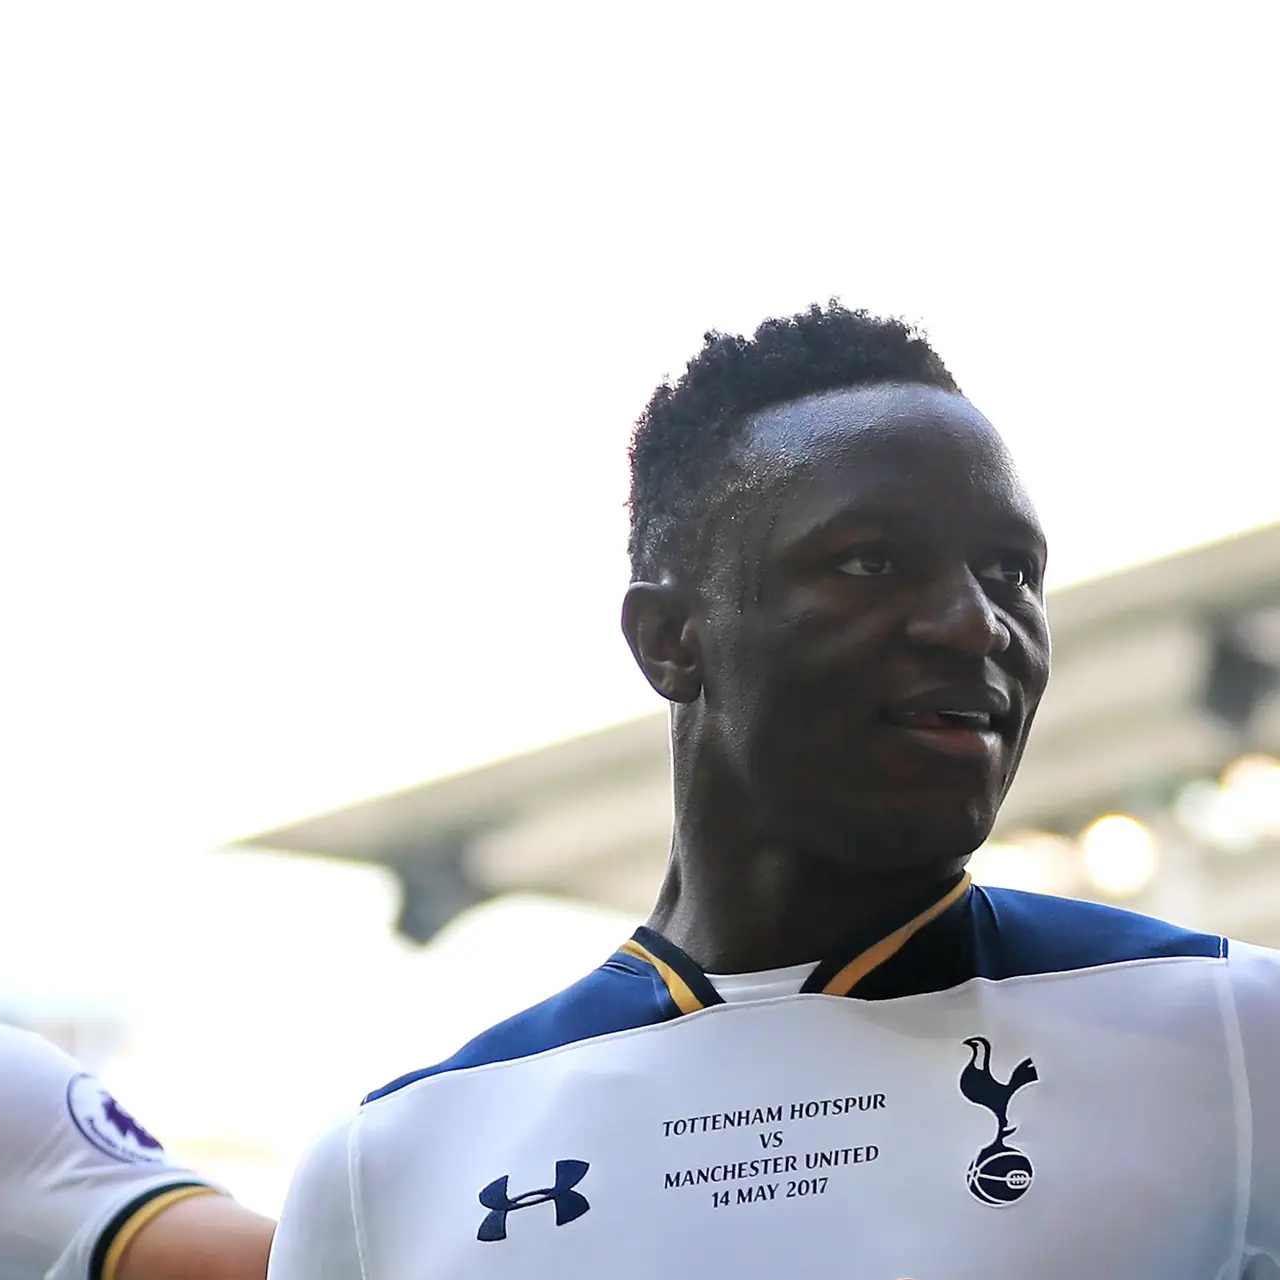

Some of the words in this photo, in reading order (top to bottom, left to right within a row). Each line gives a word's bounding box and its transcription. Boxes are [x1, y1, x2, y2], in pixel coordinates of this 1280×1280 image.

[662, 1105, 783, 1138] TOTTENHAM
[789, 1093, 887, 1121] HOTSPUR
[759, 1130, 784, 1149] VS
[663, 1154, 798, 1189] MANCHESTER
[805, 1145, 880, 1169] UNITED
[711, 1190, 731, 1208] 14
[736, 1183, 780, 1205] MAY
[786, 1177, 829, 1198] 2017
